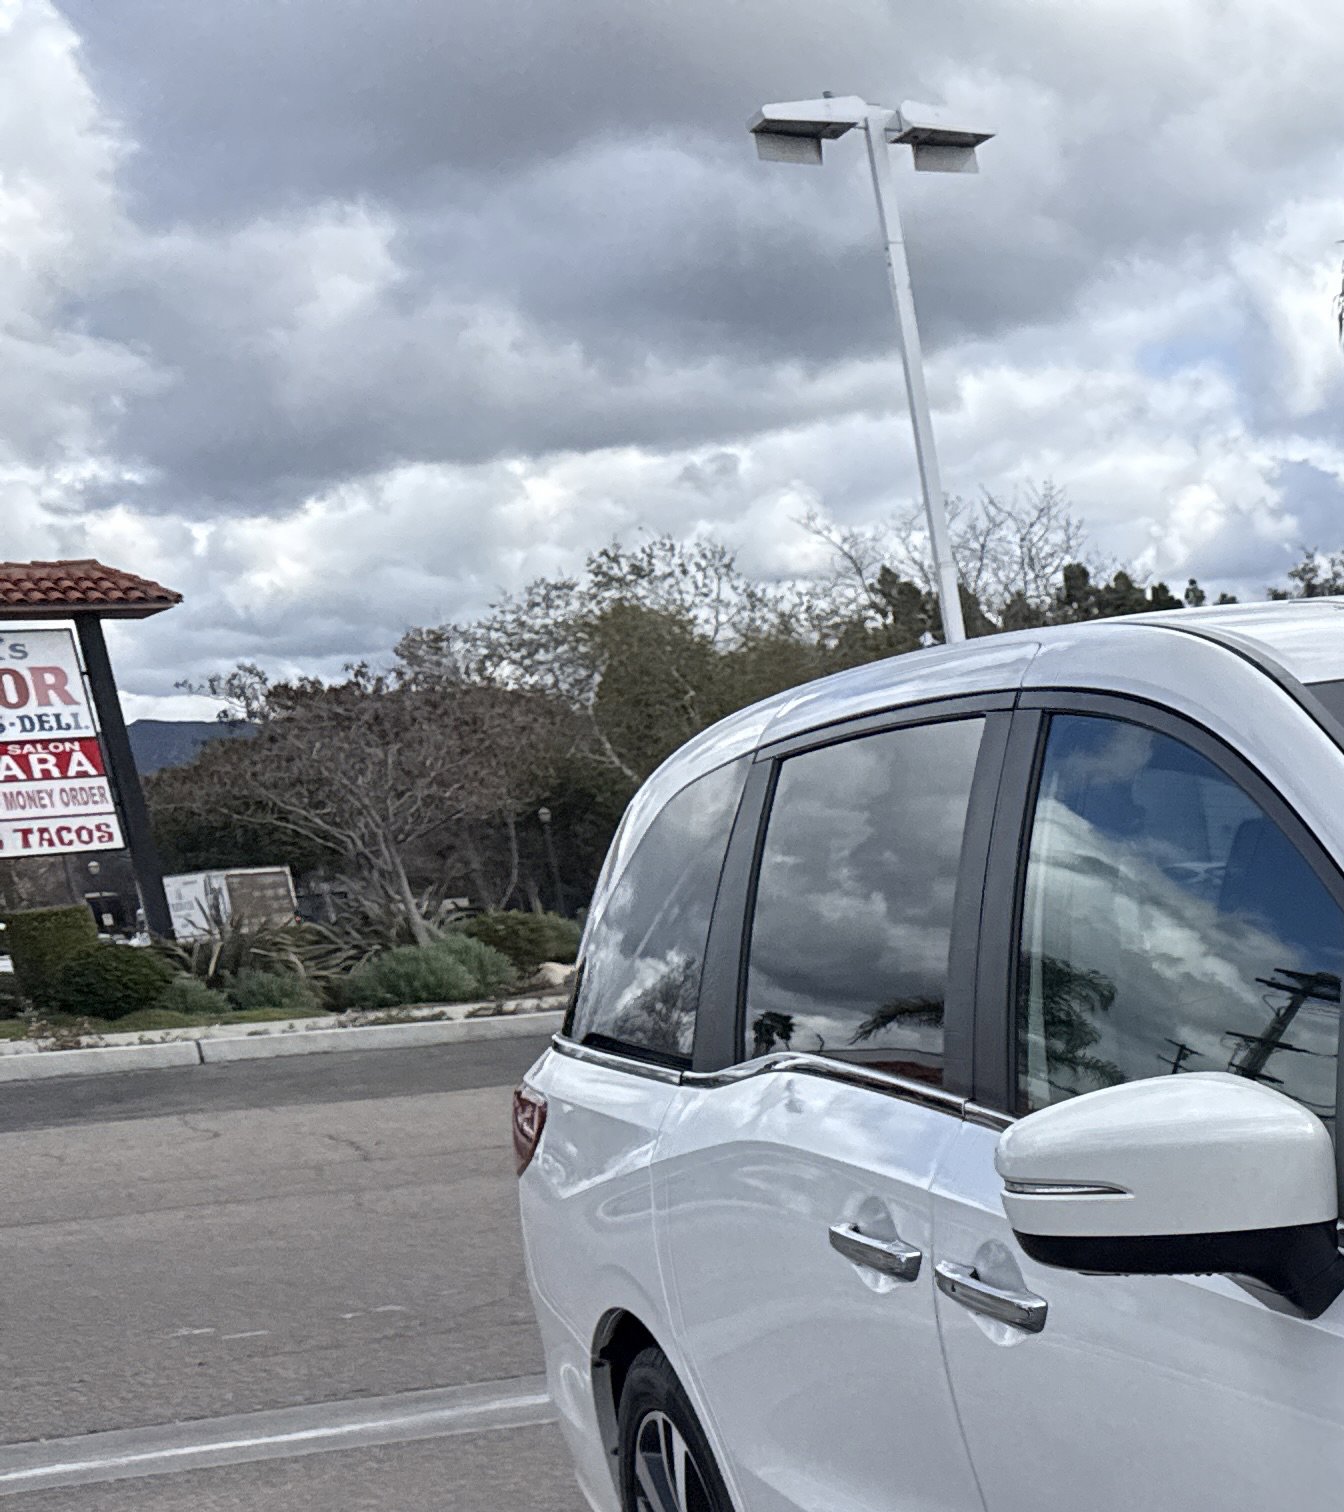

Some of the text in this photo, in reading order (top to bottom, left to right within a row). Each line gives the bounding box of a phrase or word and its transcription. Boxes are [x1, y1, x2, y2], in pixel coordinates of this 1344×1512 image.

[0, 637, 28, 660] S
[7, 741, 80, 755] SALON
[2, 785, 109, 811] MONEY ORDER
[13, 822, 114, 849] TACOS
